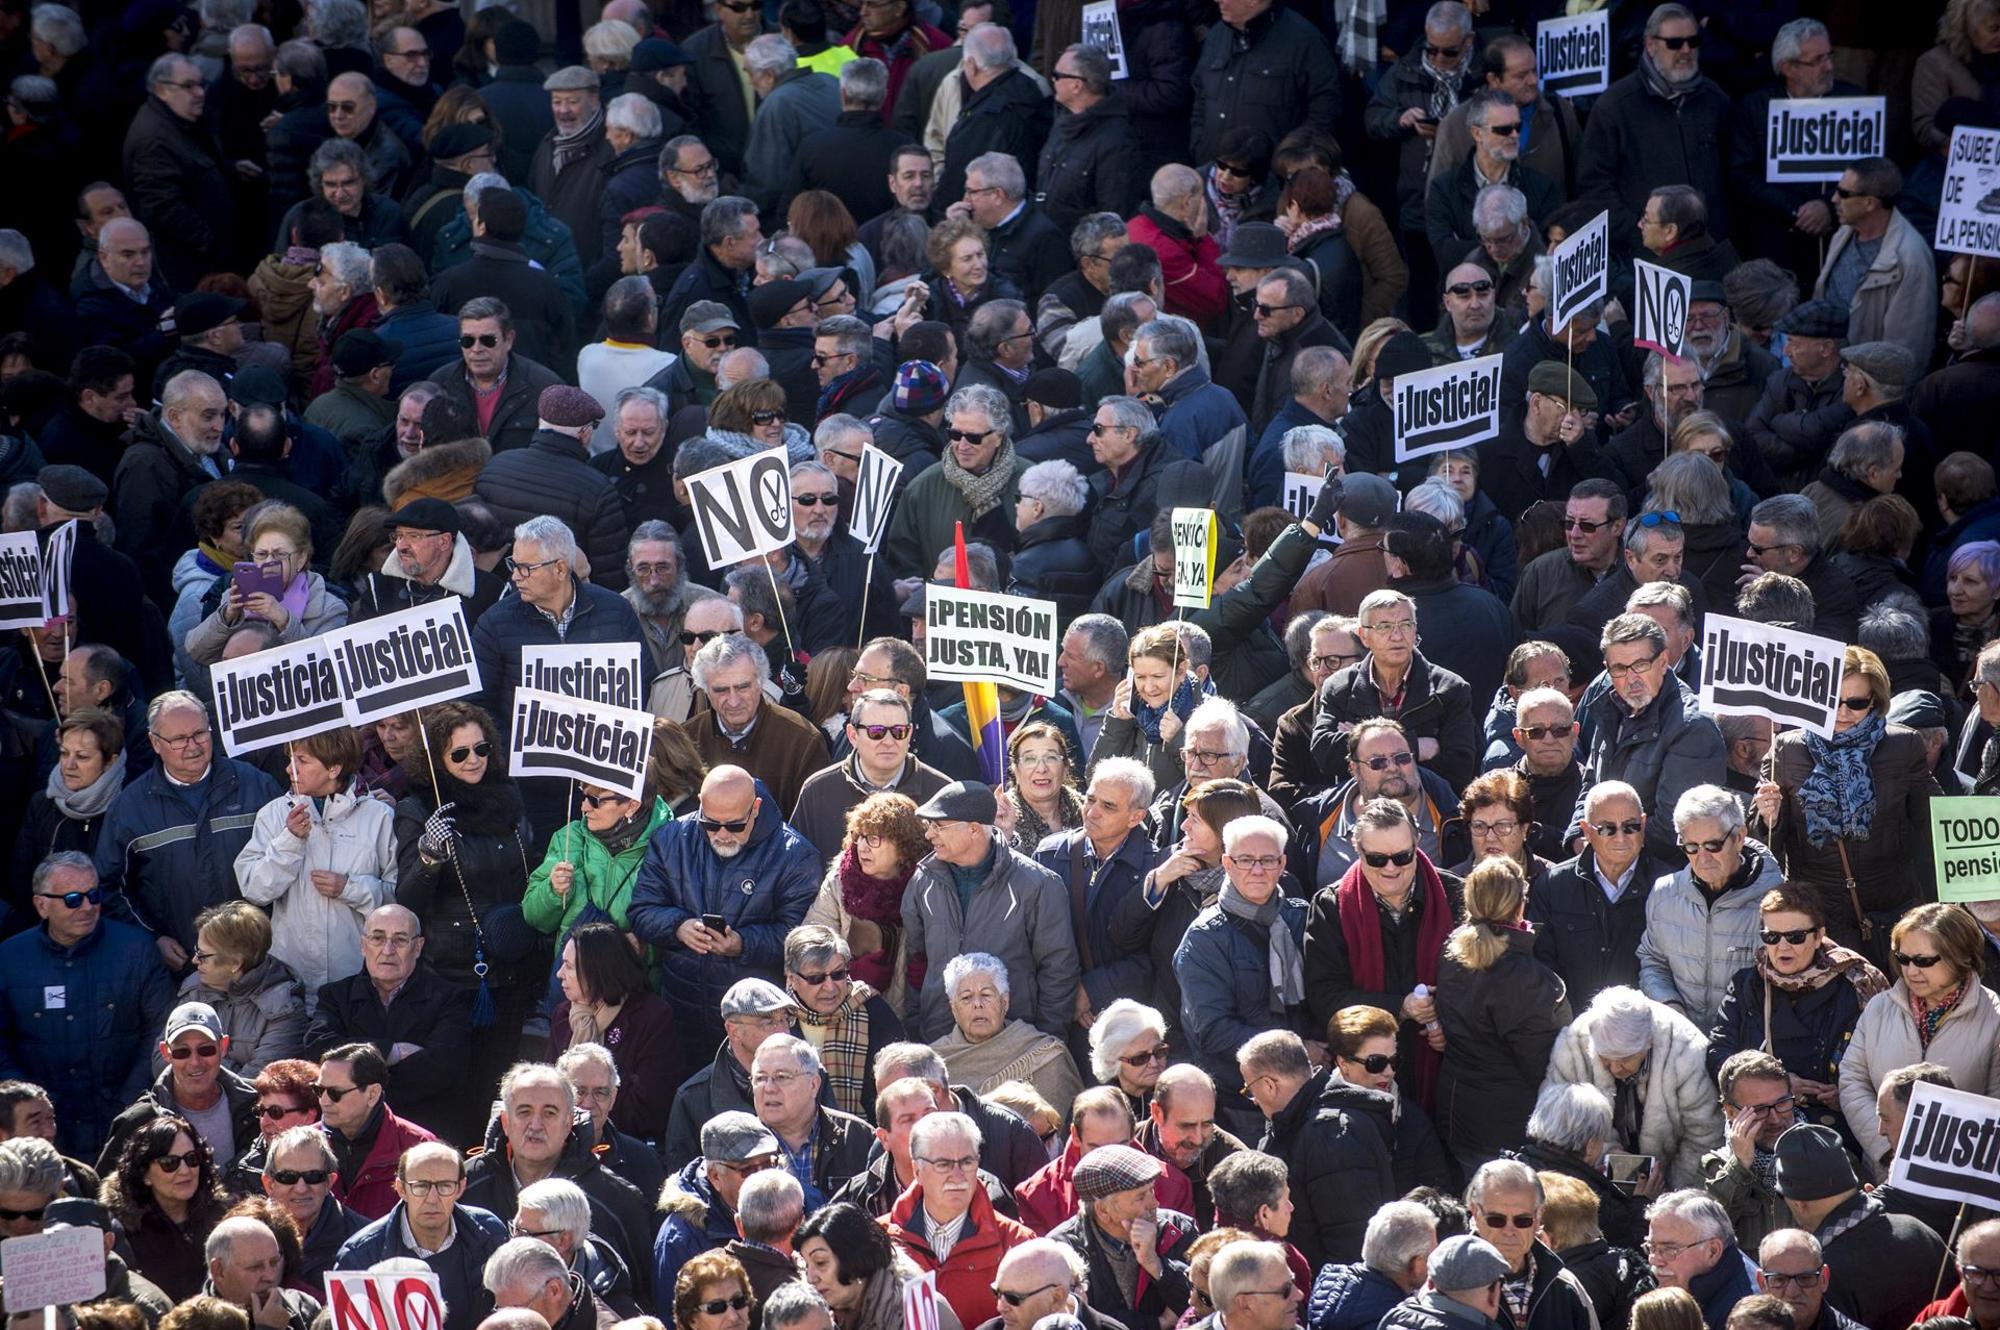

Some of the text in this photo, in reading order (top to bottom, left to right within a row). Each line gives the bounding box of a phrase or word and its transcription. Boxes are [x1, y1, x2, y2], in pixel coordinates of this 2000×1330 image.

[1539, 22, 1606, 80] ¡Justicia!
[1770, 110, 1882, 160] ¡Justicia!
[1950, 134, 1994, 167] ¡SUBE
[1945, 175, 1965, 203] DE
[1938, 217, 1956, 245] LA
[1555, 224, 1607, 311] ¡Justicia!
[1638, 265, 1687, 355] NO
[1397, 366, 1499, 439] ¡Justicia!
[691, 456, 791, 562] NO
[928, 598, 1052, 641] ¡PENSIÓN
[335, 611, 473, 700] ¡Justicia!
[928, 636, 1050, 680] JUSTA, YA!
[1703, 628, 1842, 710] ¡Justicia!
[217, 653, 342, 731] ¡Justicia
[513, 699, 650, 775] ¡Justicia!
[1939, 817, 2000, 843] TODO
[1944, 851, 2000, 884] pensi
[1900, 1100, 2000, 1176] ¡Justi
